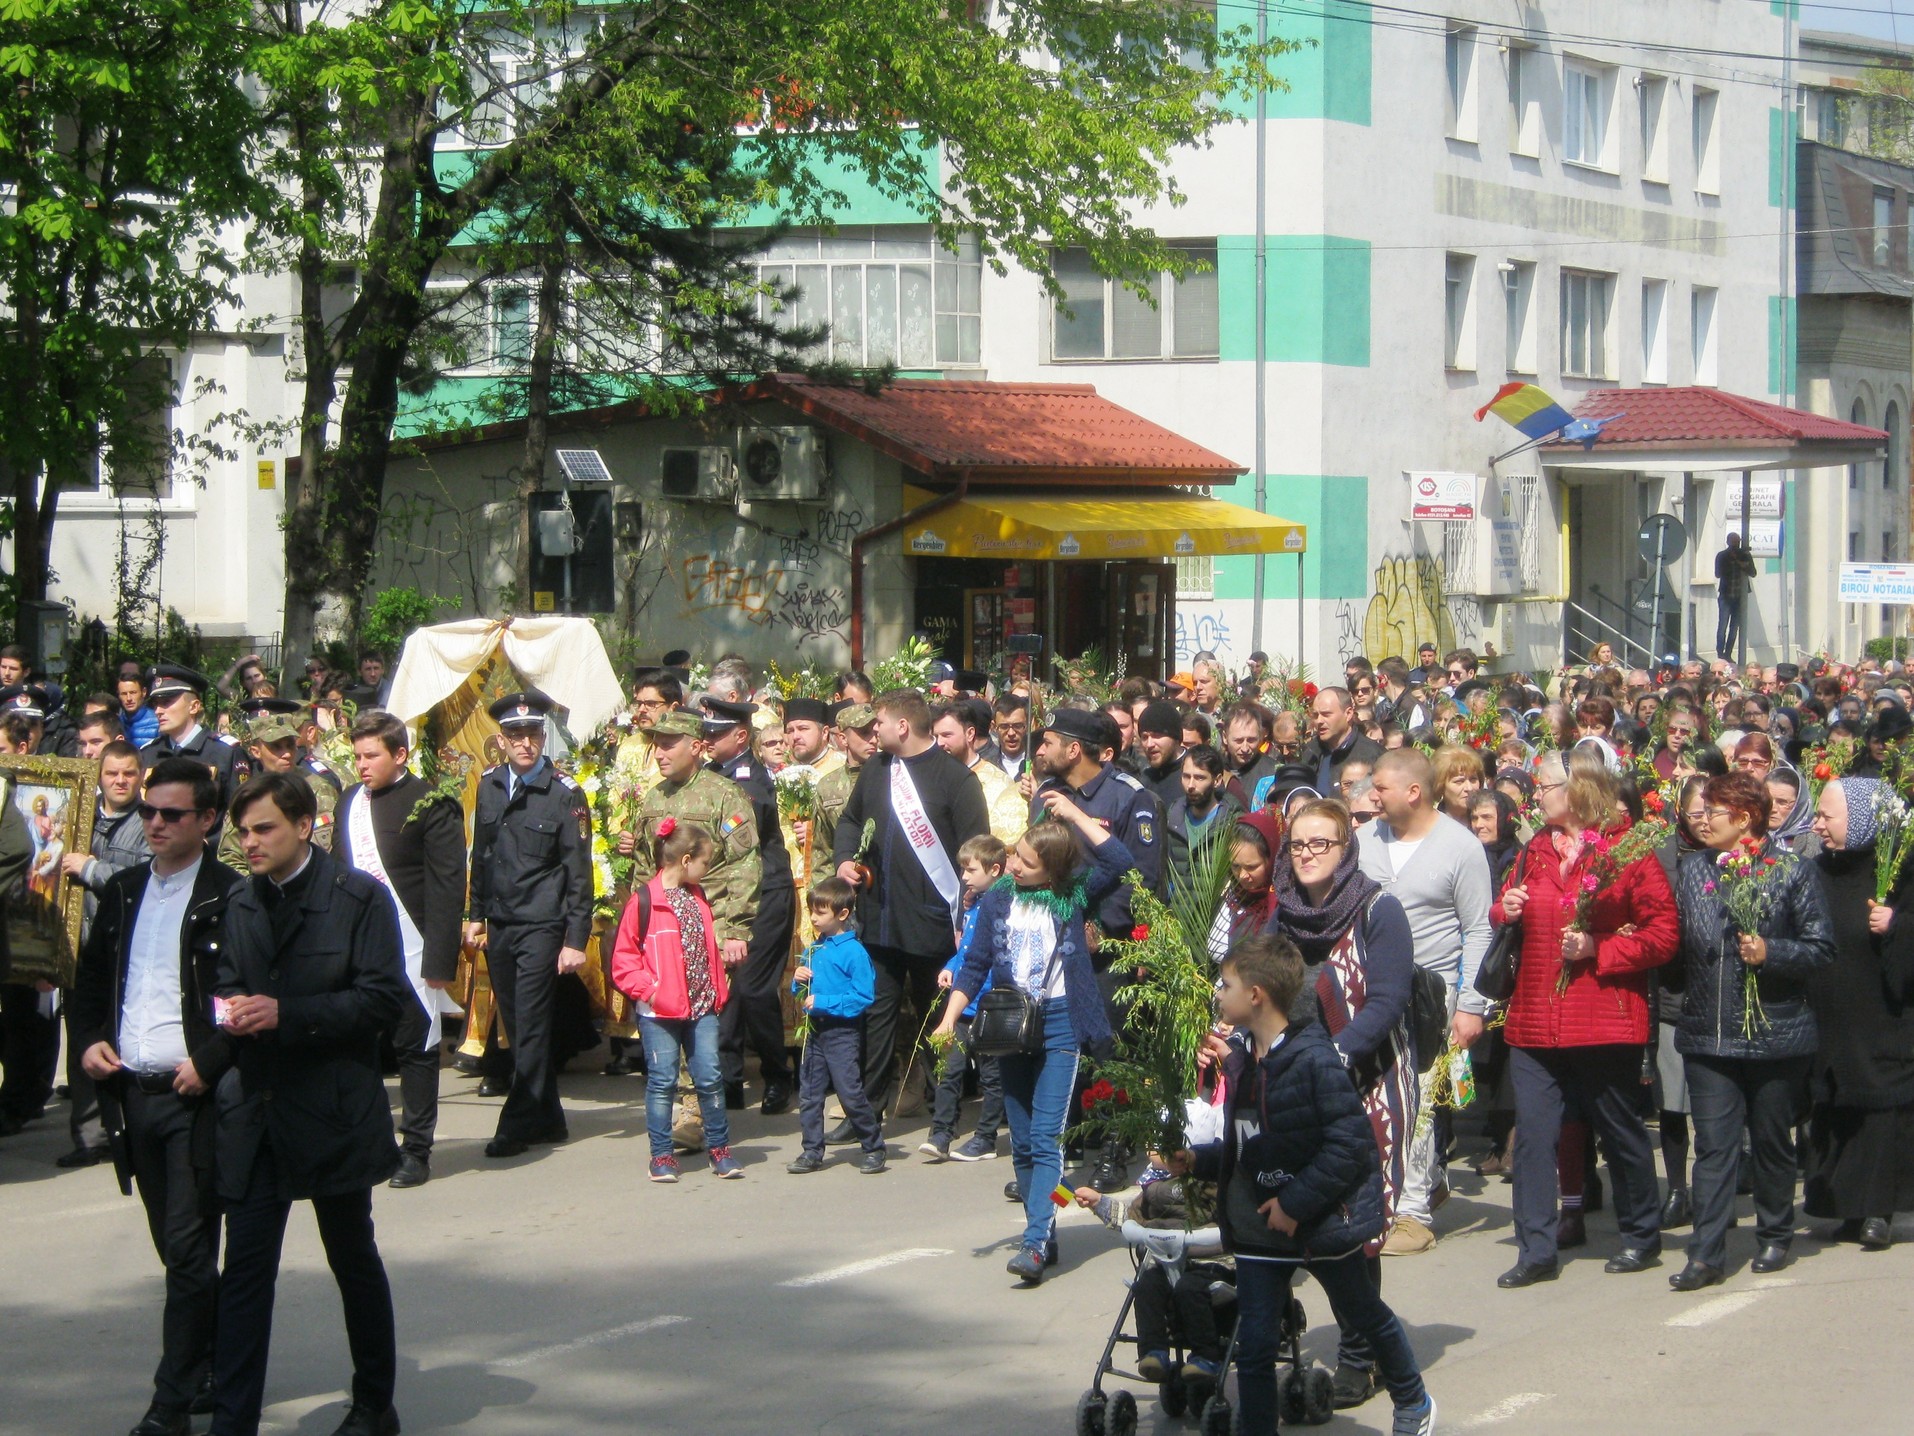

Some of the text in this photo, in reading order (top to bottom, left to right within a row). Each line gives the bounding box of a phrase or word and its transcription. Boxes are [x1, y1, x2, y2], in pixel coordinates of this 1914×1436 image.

[1749, 534, 1775, 543] OCAT
[913, 540, 945, 550] Bergenbier
[1060, 544, 1079, 553] Bergenbier
[1841, 583, 1870, 594] BIROU
[923, 616, 957, 628] GAMA
[911, 808, 936, 849] FLORII
